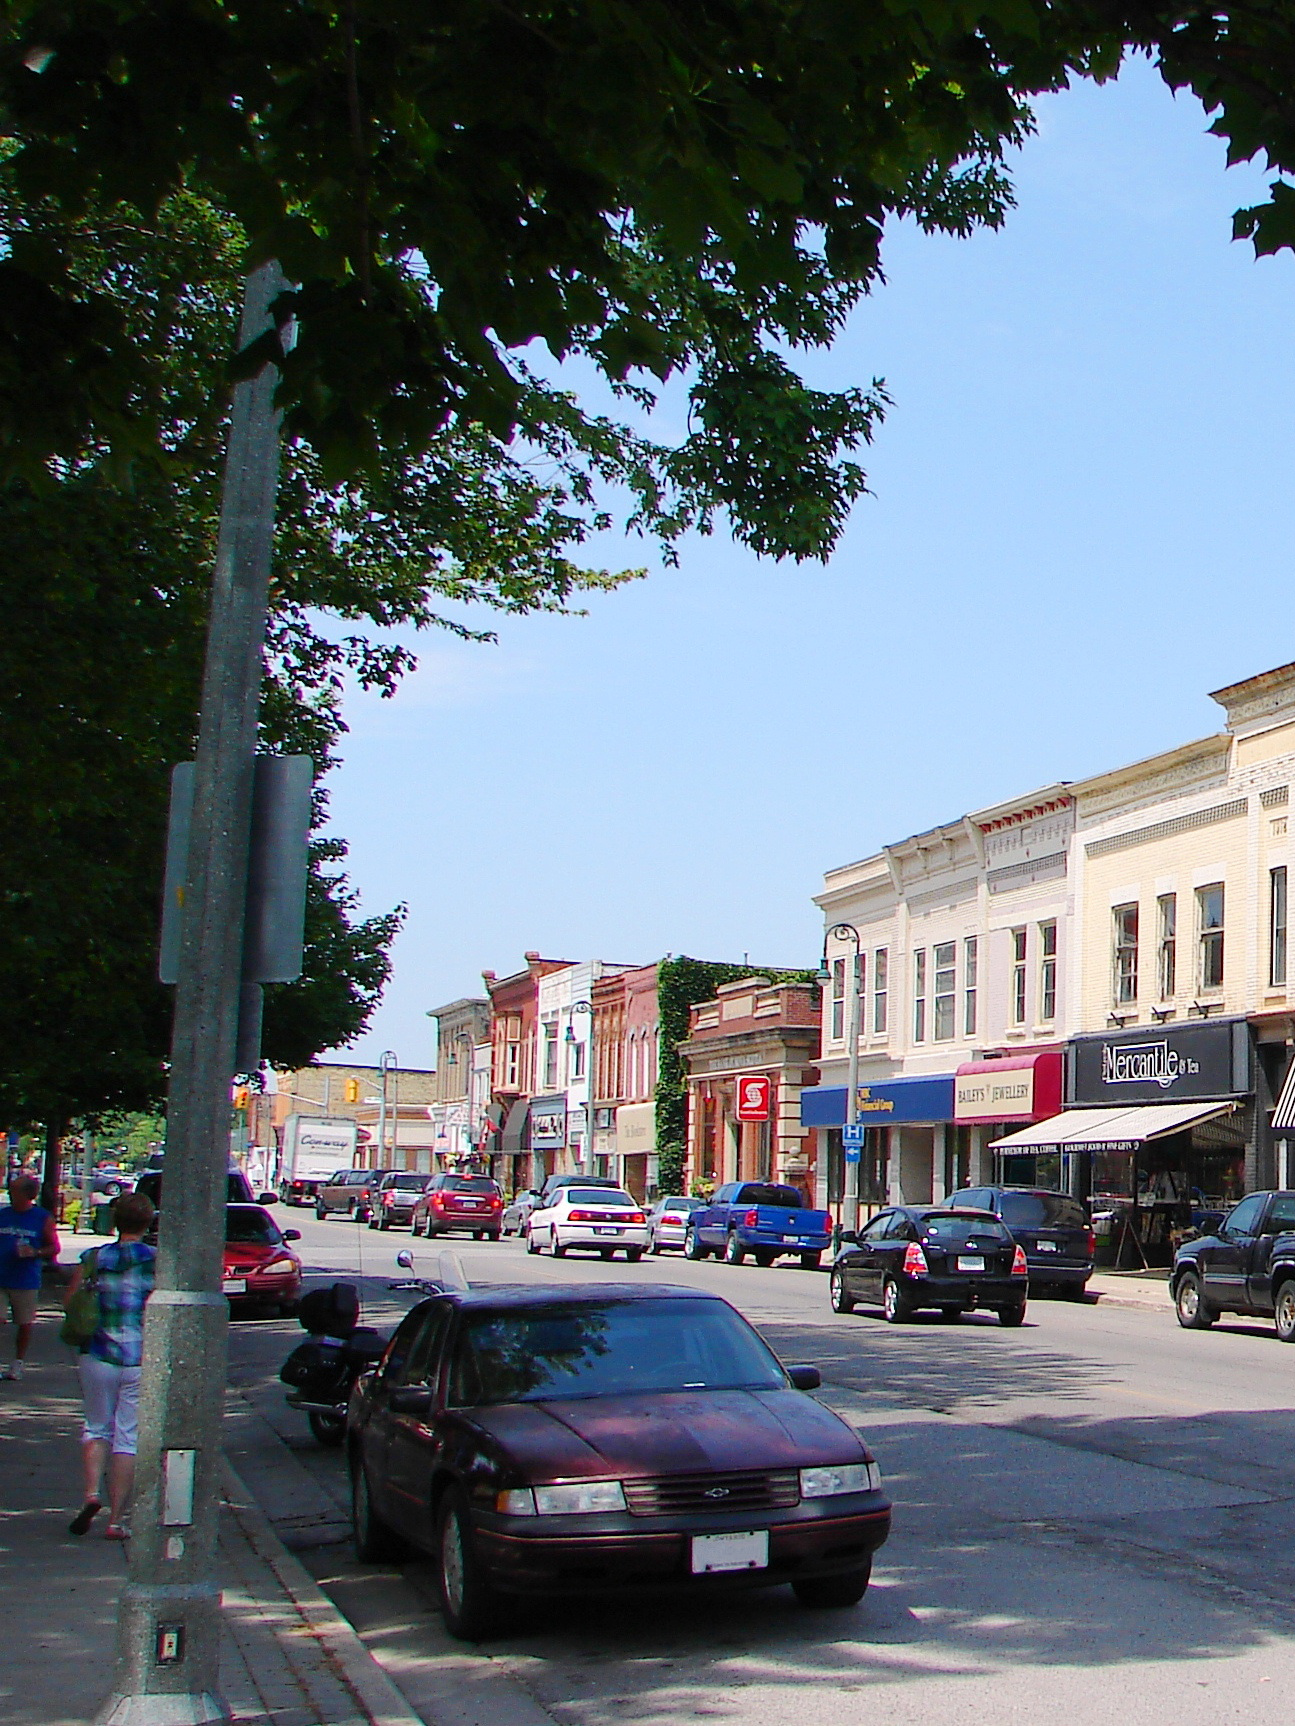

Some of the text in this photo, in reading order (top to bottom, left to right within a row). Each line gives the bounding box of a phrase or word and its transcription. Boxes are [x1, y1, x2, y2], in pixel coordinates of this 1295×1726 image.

[1106, 1039, 1178, 1080] Mercantile
[992, 1084, 1029, 1103] JEWELLERY
[847, 1126, 860, 1138] H
